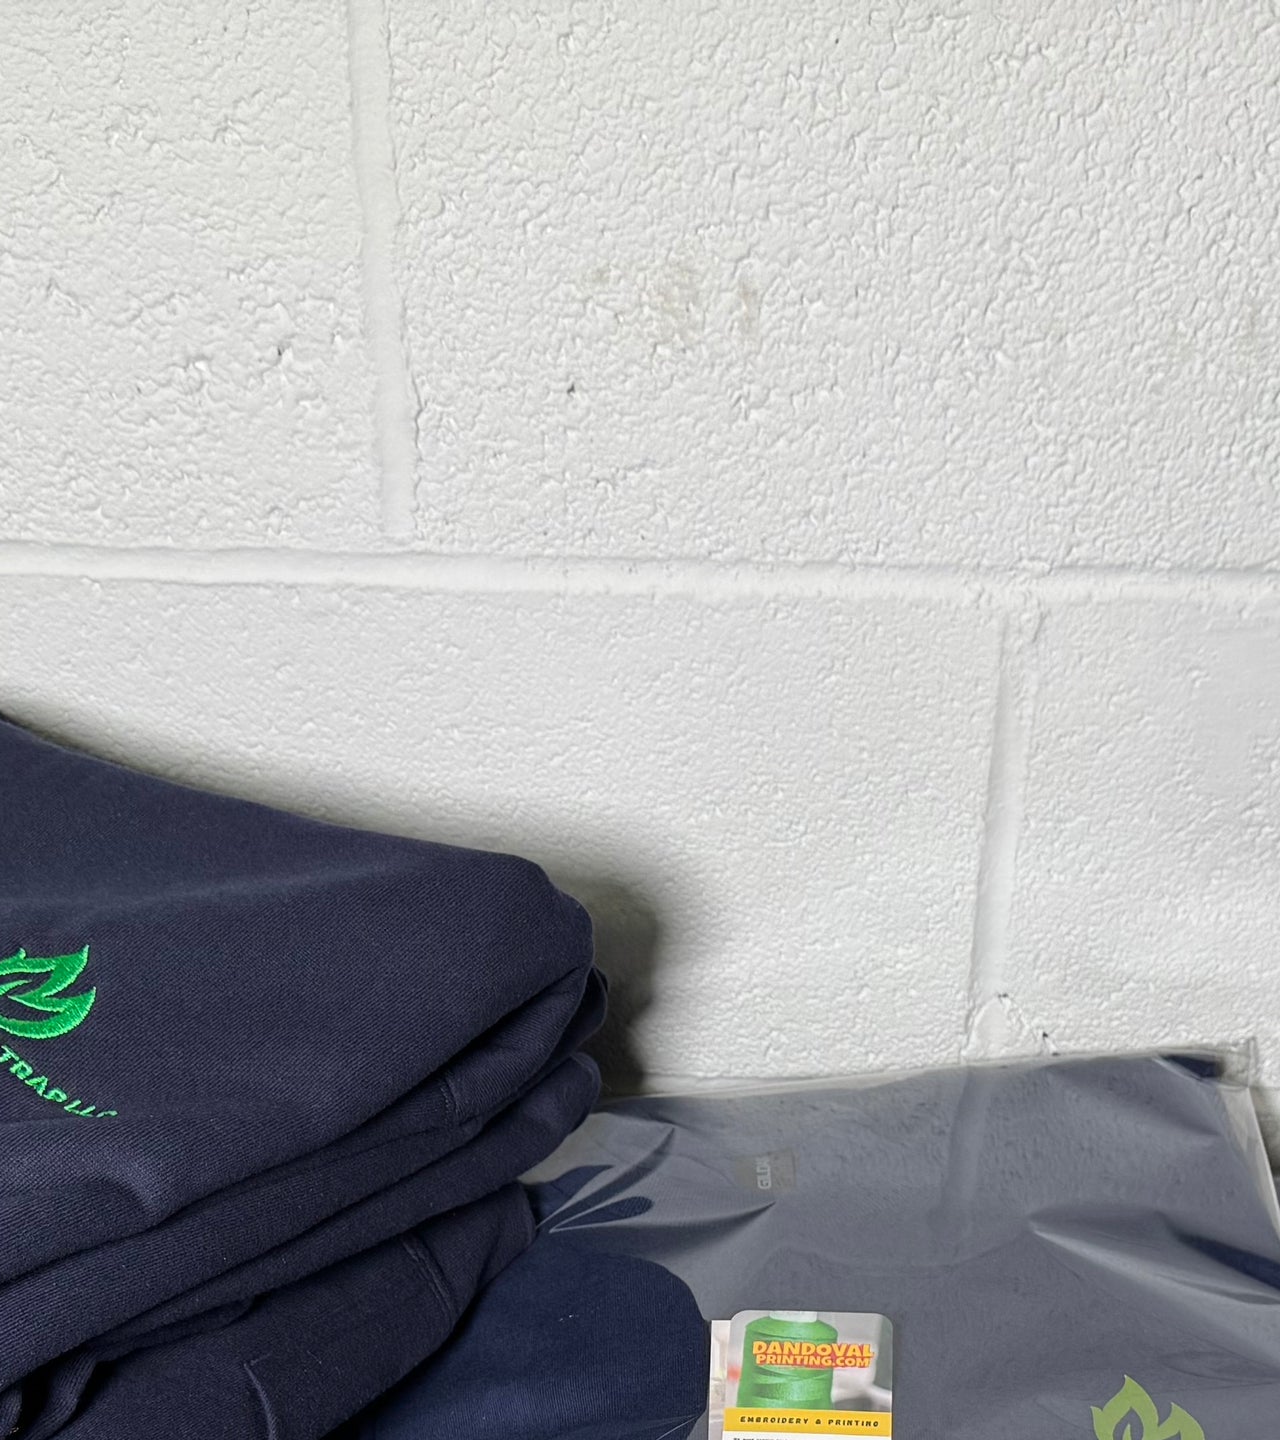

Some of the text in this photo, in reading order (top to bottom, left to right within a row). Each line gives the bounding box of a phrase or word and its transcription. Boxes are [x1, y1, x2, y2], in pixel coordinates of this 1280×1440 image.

[752, 1340, 875, 1358] DANDOVAL
[755, 1355, 871, 1368] PRINTING.COM
[740, 1416, 809, 1424] EMBROIDERY
[828, 1419, 879, 1427] PRINTING
